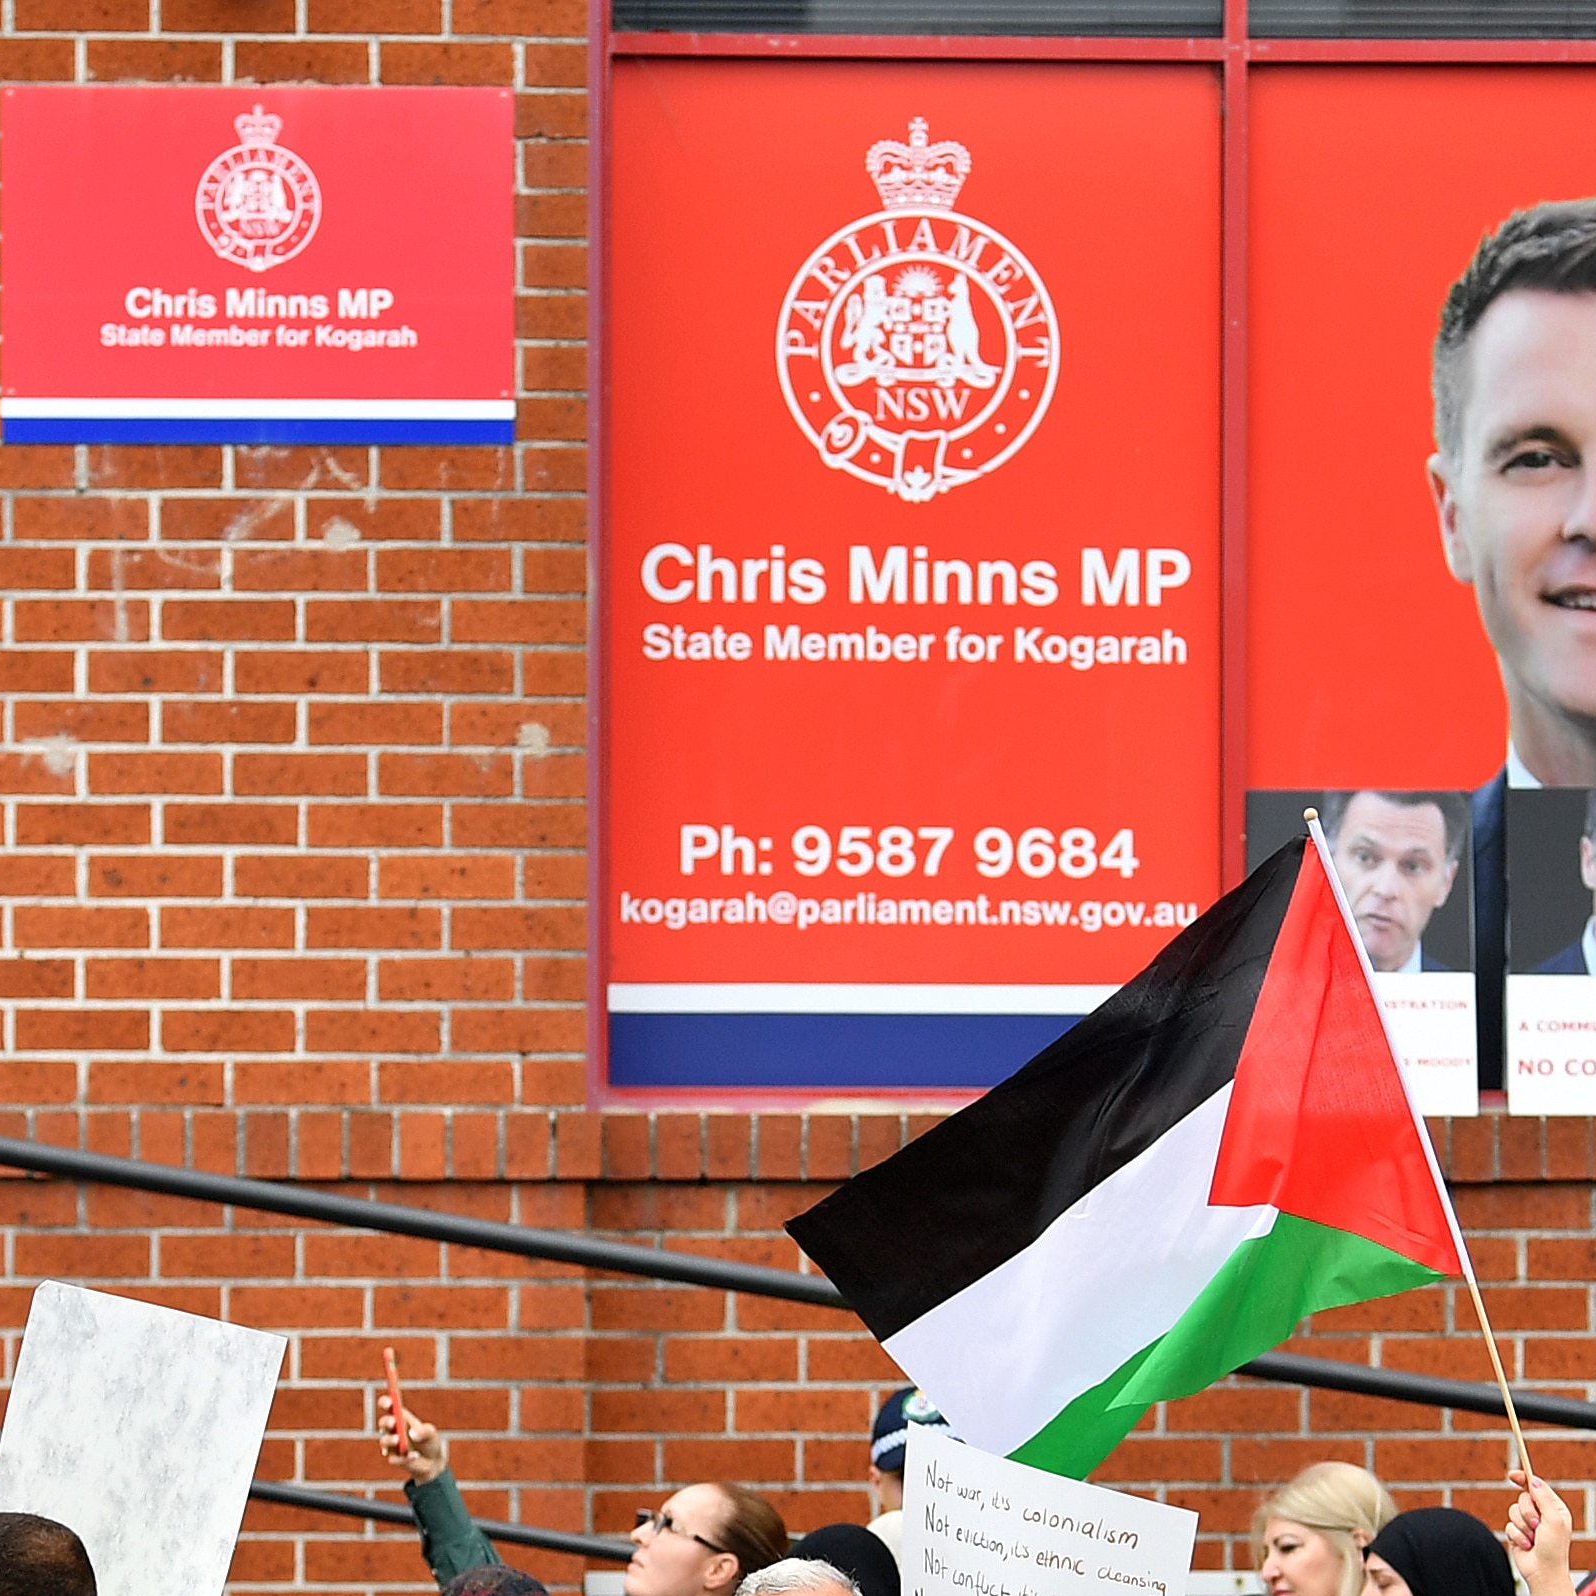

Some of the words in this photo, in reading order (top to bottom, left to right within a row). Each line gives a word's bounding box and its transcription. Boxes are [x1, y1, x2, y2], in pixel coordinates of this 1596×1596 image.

[125, 286, 217, 319] Chris
[225, 288, 329, 319] Minns
[338, 288, 393, 319] MP
[785, 216, 1051, 368] PARLIAMENT
[100, 323, 164, 348] State
[170, 323, 269, 348] Member
[276, 324, 309, 347] for
[315, 324, 418, 351] Kogarah
[875, 387, 970, 422] NSW
[640, 542, 827, 604] Chris
[848, 545, 1059, 605] Minns
[1080, 548, 1192, 607] MP
[641, 622, 752, 661] State
[764, 625, 935, 661] Member
[945, 626, 1002, 662] for
[1014, 628, 1188, 670] Kogarah
[679, 824, 774, 876] Ph:
[790, 825, 955, 877] 9587
[972, 828, 1140, 879] 9684
[620, 891, 1200, 932] kogarah@parliament.nsw.gov.au
[1519, 1021, 1529, 1032] A
[1517, 1058, 1555, 1076] NO
[925, 1459, 954, 1490] Not
[956, 1483, 986, 1511] war,
[1022, 1505, 1141, 1549] colonialism
[925, 1503, 949, 1533] Not
[956, 1525, 1009, 1562] eviction,
[1035, 1549, 1087, 1577] ethnic
[924, 1547, 949, 1580] Not
